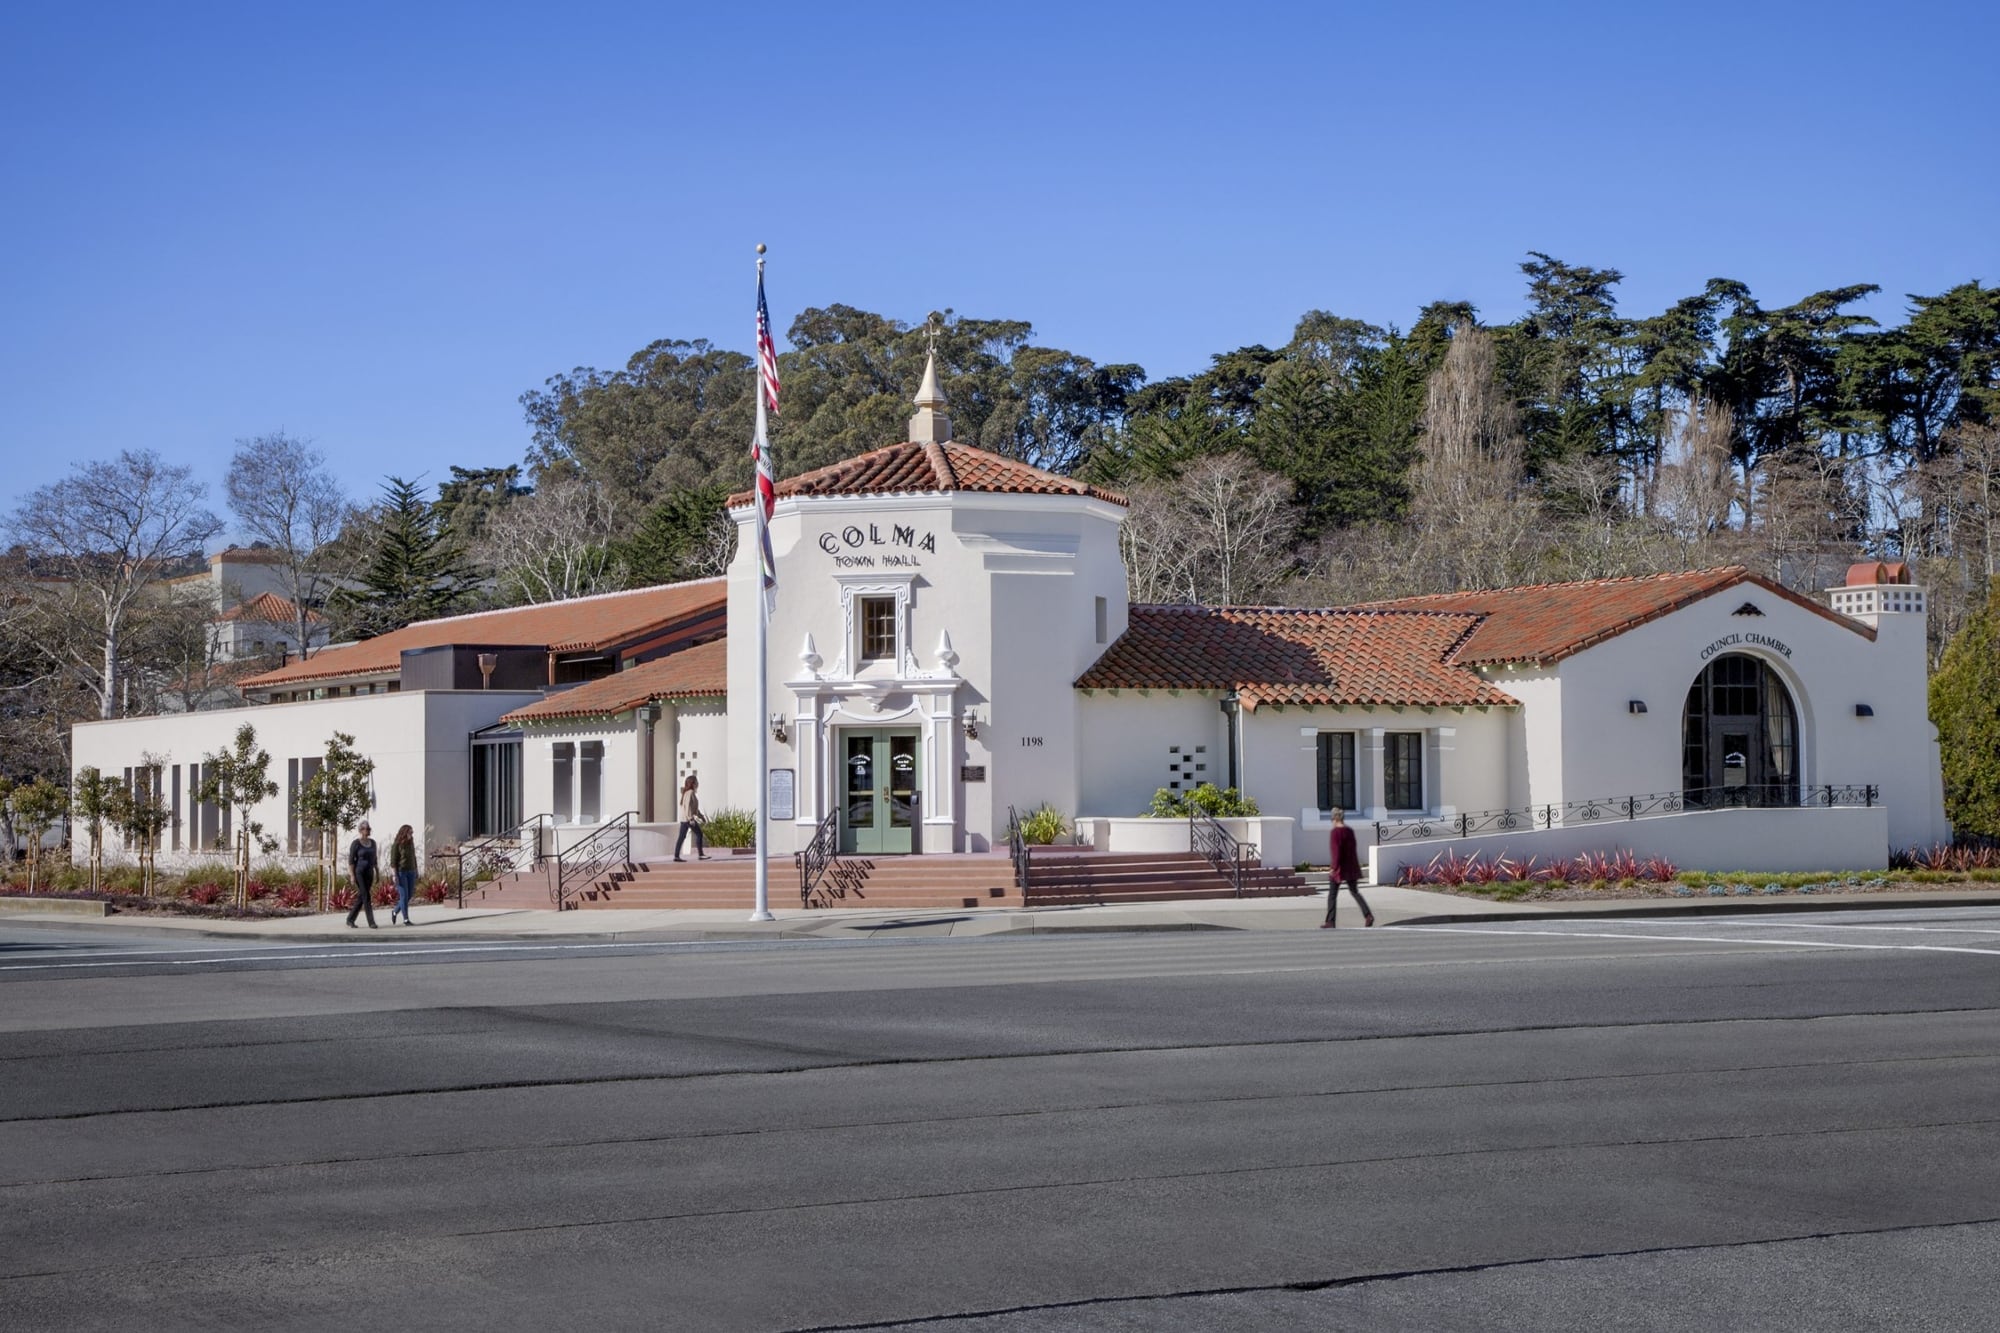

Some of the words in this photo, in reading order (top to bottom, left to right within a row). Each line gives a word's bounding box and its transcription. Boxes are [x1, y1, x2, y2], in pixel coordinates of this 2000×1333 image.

[819, 522, 935, 553] COLMA
[833, 555, 875, 567] TOWN
[882, 554, 921, 567] HALL
[1700, 633, 1742, 660] COUNCIL
[1745, 632, 1792, 659] CHAMBER
[1022, 736, 1043, 747] 1198
